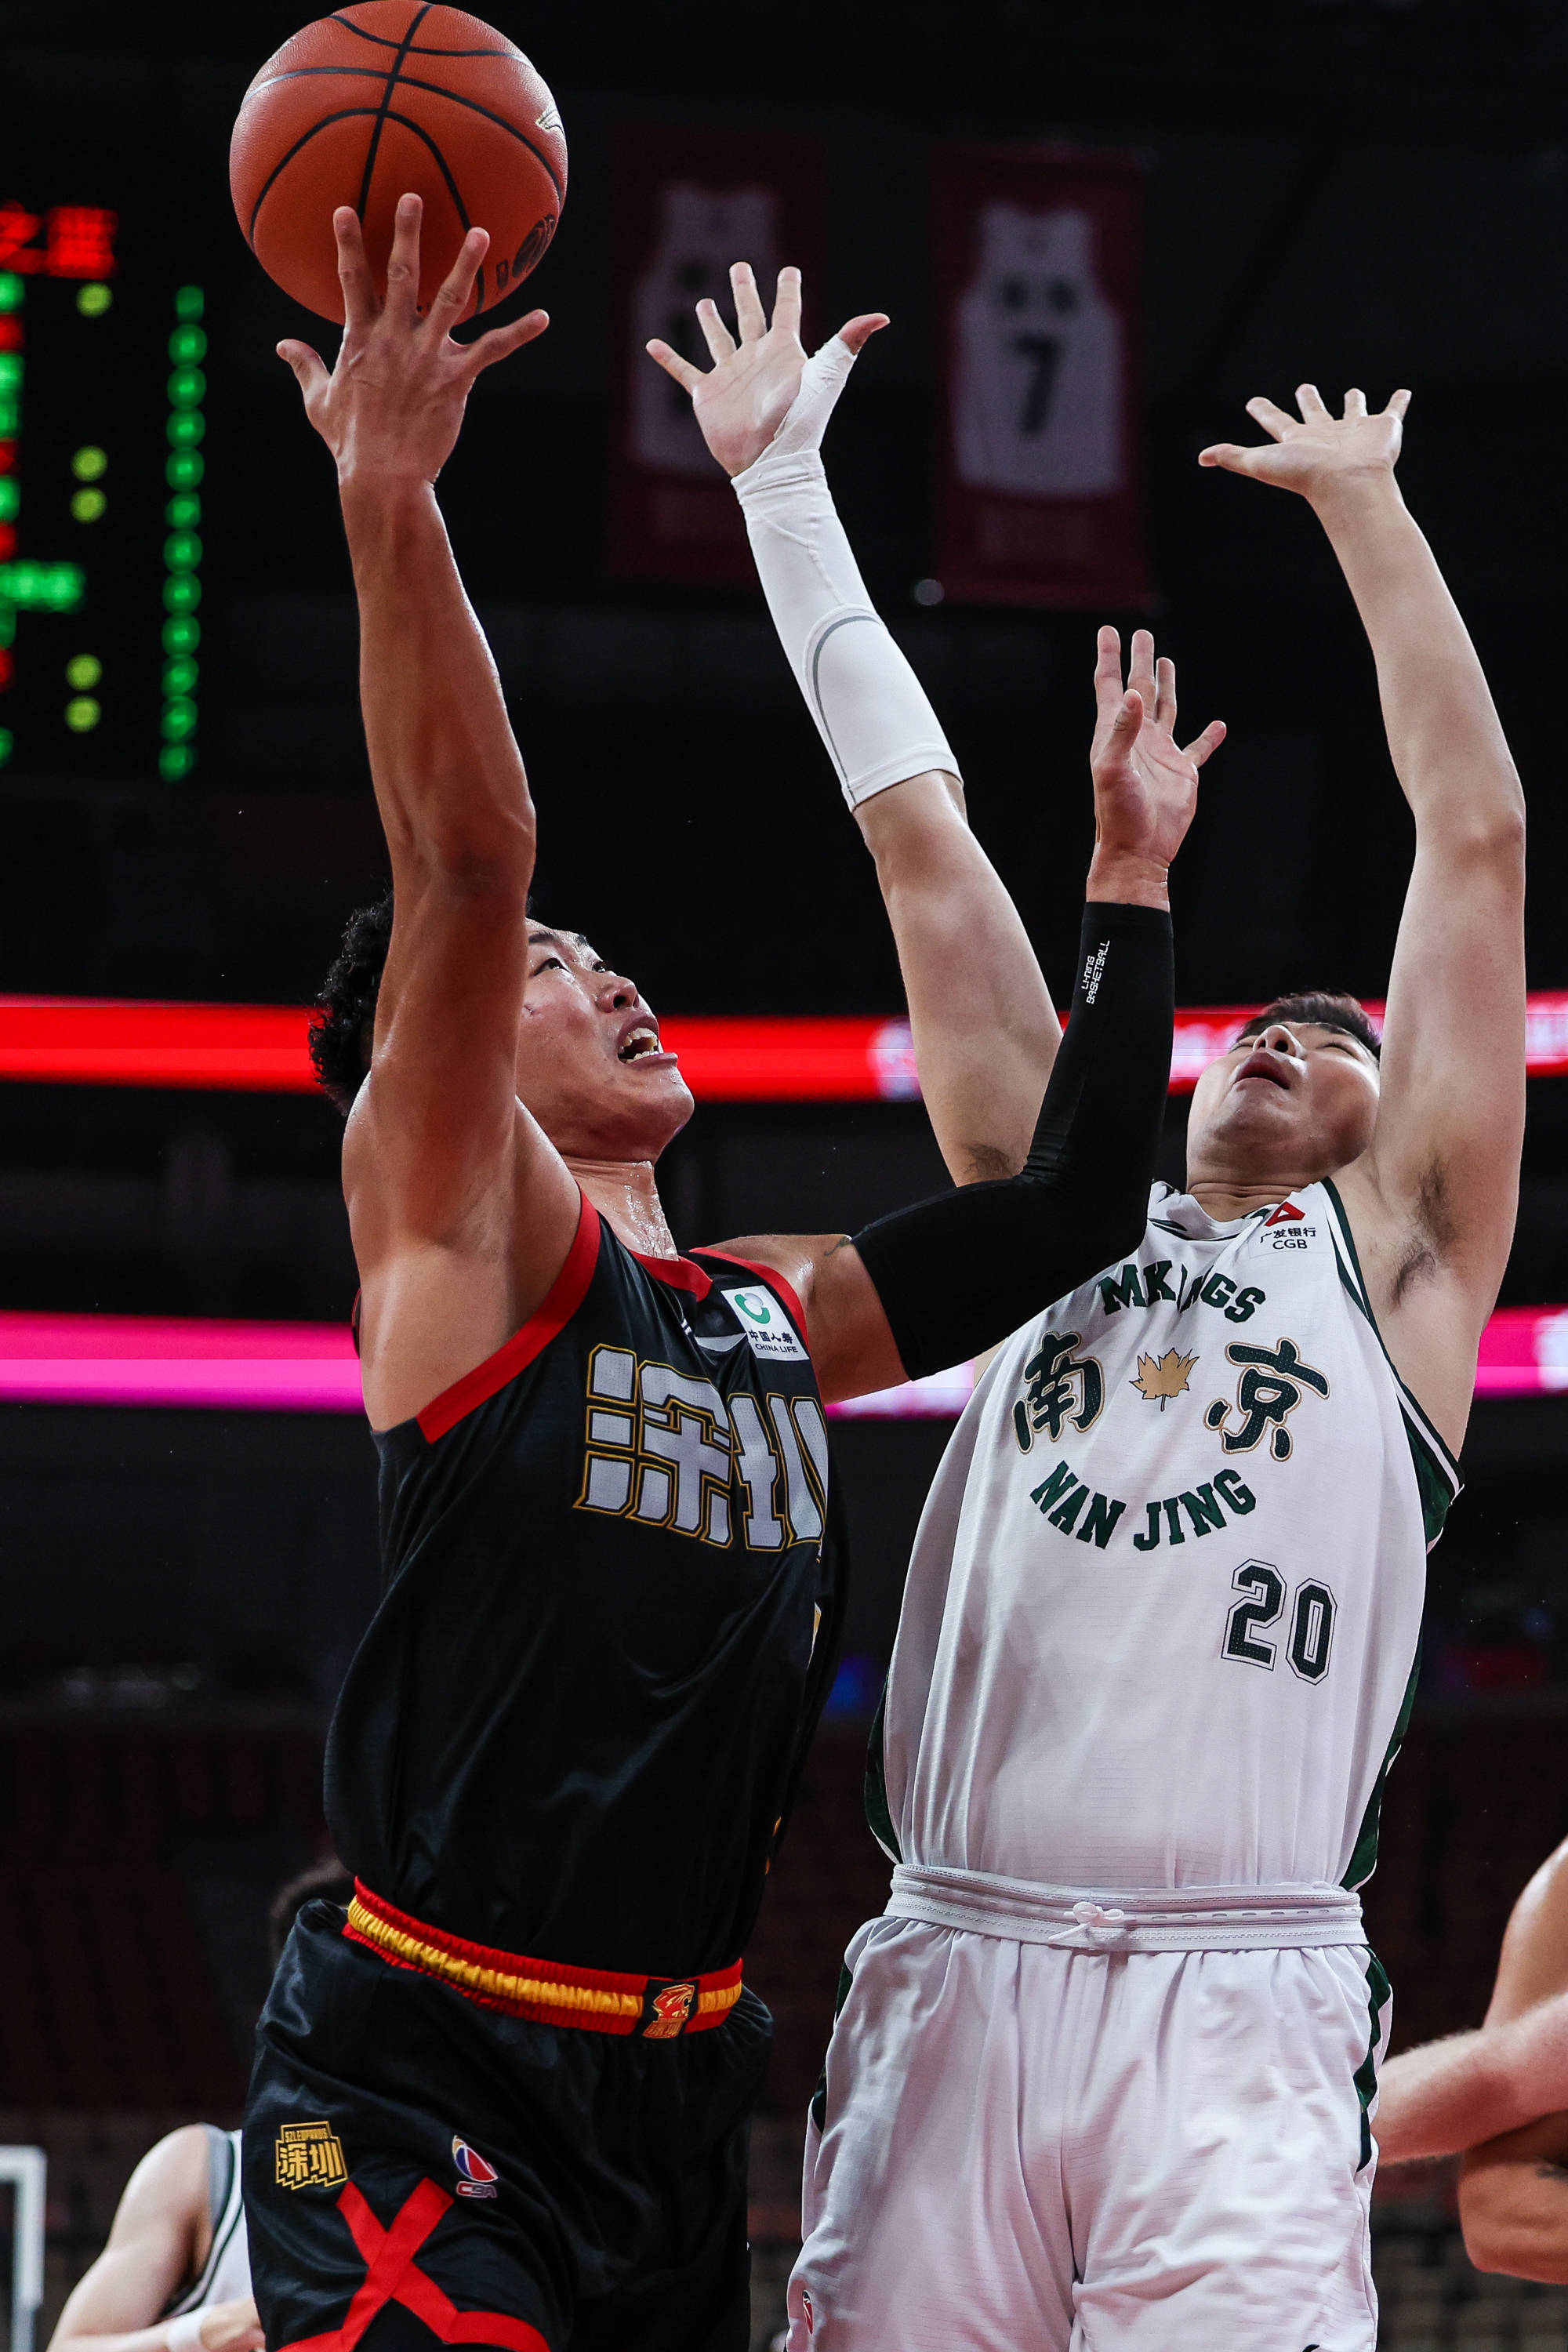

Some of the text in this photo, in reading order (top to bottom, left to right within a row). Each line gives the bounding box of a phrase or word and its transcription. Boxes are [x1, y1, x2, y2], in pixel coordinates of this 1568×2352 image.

[1086, 940, 1110, 1004] BASKETBALL
[1260, 1227, 1316, 1243] 广发银行
[1272, 1239, 1308, 1250] CGB
[749, 1330, 793, 1345] 中国人寿
[755, 1343, 779, 1352] CHINA
[572, 1343, 829, 1552] 深圳
[1029, 1461, 1257, 1552] NAN JING
[1221, 1559, 1337, 1686] 20
[279, 2141, 343, 2181] 深圳
[456, 2181, 497, 2198] CBA
